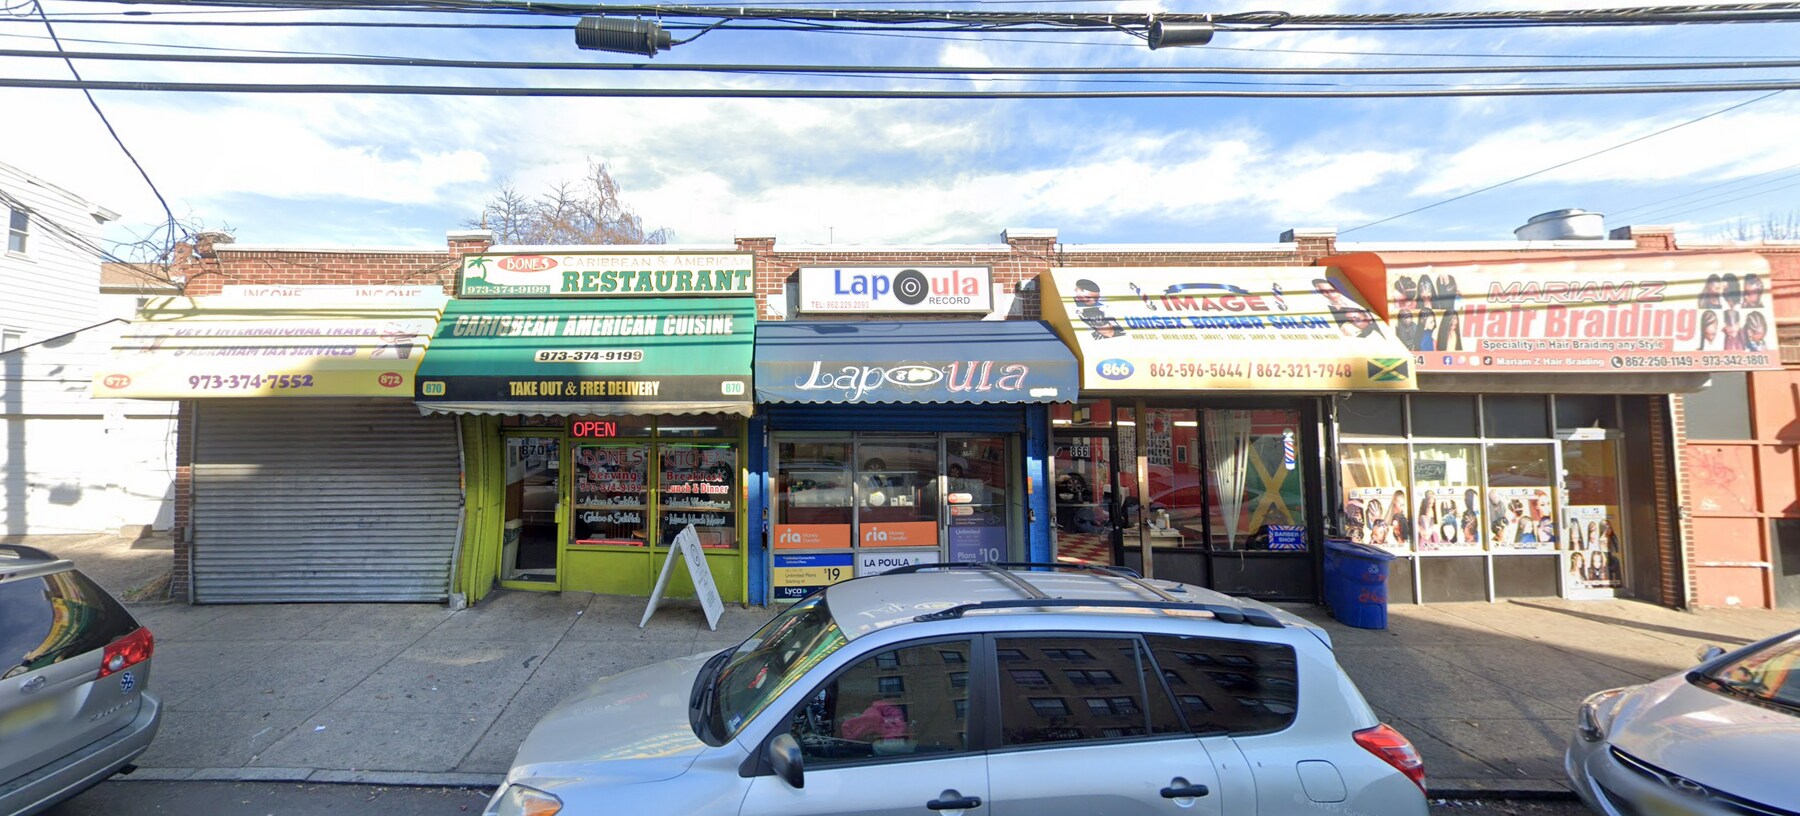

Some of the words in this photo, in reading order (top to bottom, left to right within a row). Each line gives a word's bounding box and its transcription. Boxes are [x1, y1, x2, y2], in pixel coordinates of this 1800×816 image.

[506, 257, 550, 271] BONES
[562, 256, 651, 267] CARIBBEAN
[657, 256, 667, 267] &
[560, 269, 752, 293] RESTAURANT
[467, 284, 549, 295] 973-374-9199
[1487, 281, 1634, 303] MARIAM
[1635, 281, 1667, 303] Z
[811, 301, 825, 309] TEL:
[826, 301, 869, 309] 862.229.2093
[928, 296, 971, 305] RECORD
[1159, 295, 1271, 312] IMAGE
[452, 315, 560, 337] CARIBBEAN
[562, 314, 658, 336] AMERICAN
[662, 314, 734, 336] CUISINE
[1123, 315, 1187, 330] UNISEX
[1187, 314, 1266, 330] BARBER
[1266, 314, 1331, 330] SALON
[1462, 303, 1537, 338] Hair
[1543, 303, 1698, 342] Braiding
[1483, 340, 1533, 351] Speciality
[1536, 340, 1546, 349] in
[1549, 340, 1571, 349] Hair
[1573, 340, 1614, 350] Braiding
[1617, 341, 1636, 350] any
[1638, 339, 1665, 350] Style
[540, 351, 642, 361] 973-374-9199
[1496, 357, 1533, 366] Mariam
[1543, 357, 1563, 366] Hair
[1565, 357, 1605, 367] Braiding
[1625, 356, 1693, 366] 862-250-1149
[1703, 355, 1769, 366] 973-342-1801
[1100, 363, 1128, 377] 866
[1149, 363, 1243, 378] 862-596-5644
[1246, 362, 1252, 379] /
[1256, 363, 1352, 378] 862-321-7948
[104, 375, 129, 388] 872
[188, 374, 314, 389] 973-374-7552
[380, 375, 402, 387] 872
[425, 383, 443, 394] 870
[509, 381, 539, 396] TAKE
[540, 381, 562, 396] OUT
[565, 381, 578, 395] &
[580, 381, 606, 396] FREE
[607, 381, 660, 396] DELIVERY
[725, 383, 742, 394] 870
[573, 421, 617, 437] OPEN
[521, 445, 545, 456] 870
[583, 449, 643, 466] BONES
[1071, 446, 1088, 457] 866
[664, 449, 726, 467] KITCHEN
[588, 469, 642, 482] Serving:
[666, 471, 723, 482] Breakfast
[580, 482, 642, 493] 973-374-9199
[665, 482, 691, 493] Lunch
[692, 483, 699, 493] &
[700, 482, 729, 494] Dinner
[779, 528, 801, 544] ria
[865, 526, 888, 542] ria
[957, 551, 977, 559] Plans
[979, 547, 999, 562] $10
[864, 559, 876, 567] LA
[878, 558, 910, 567] POULA
[824, 567, 840, 581] $19
[784, 587, 802, 596] Lyca
